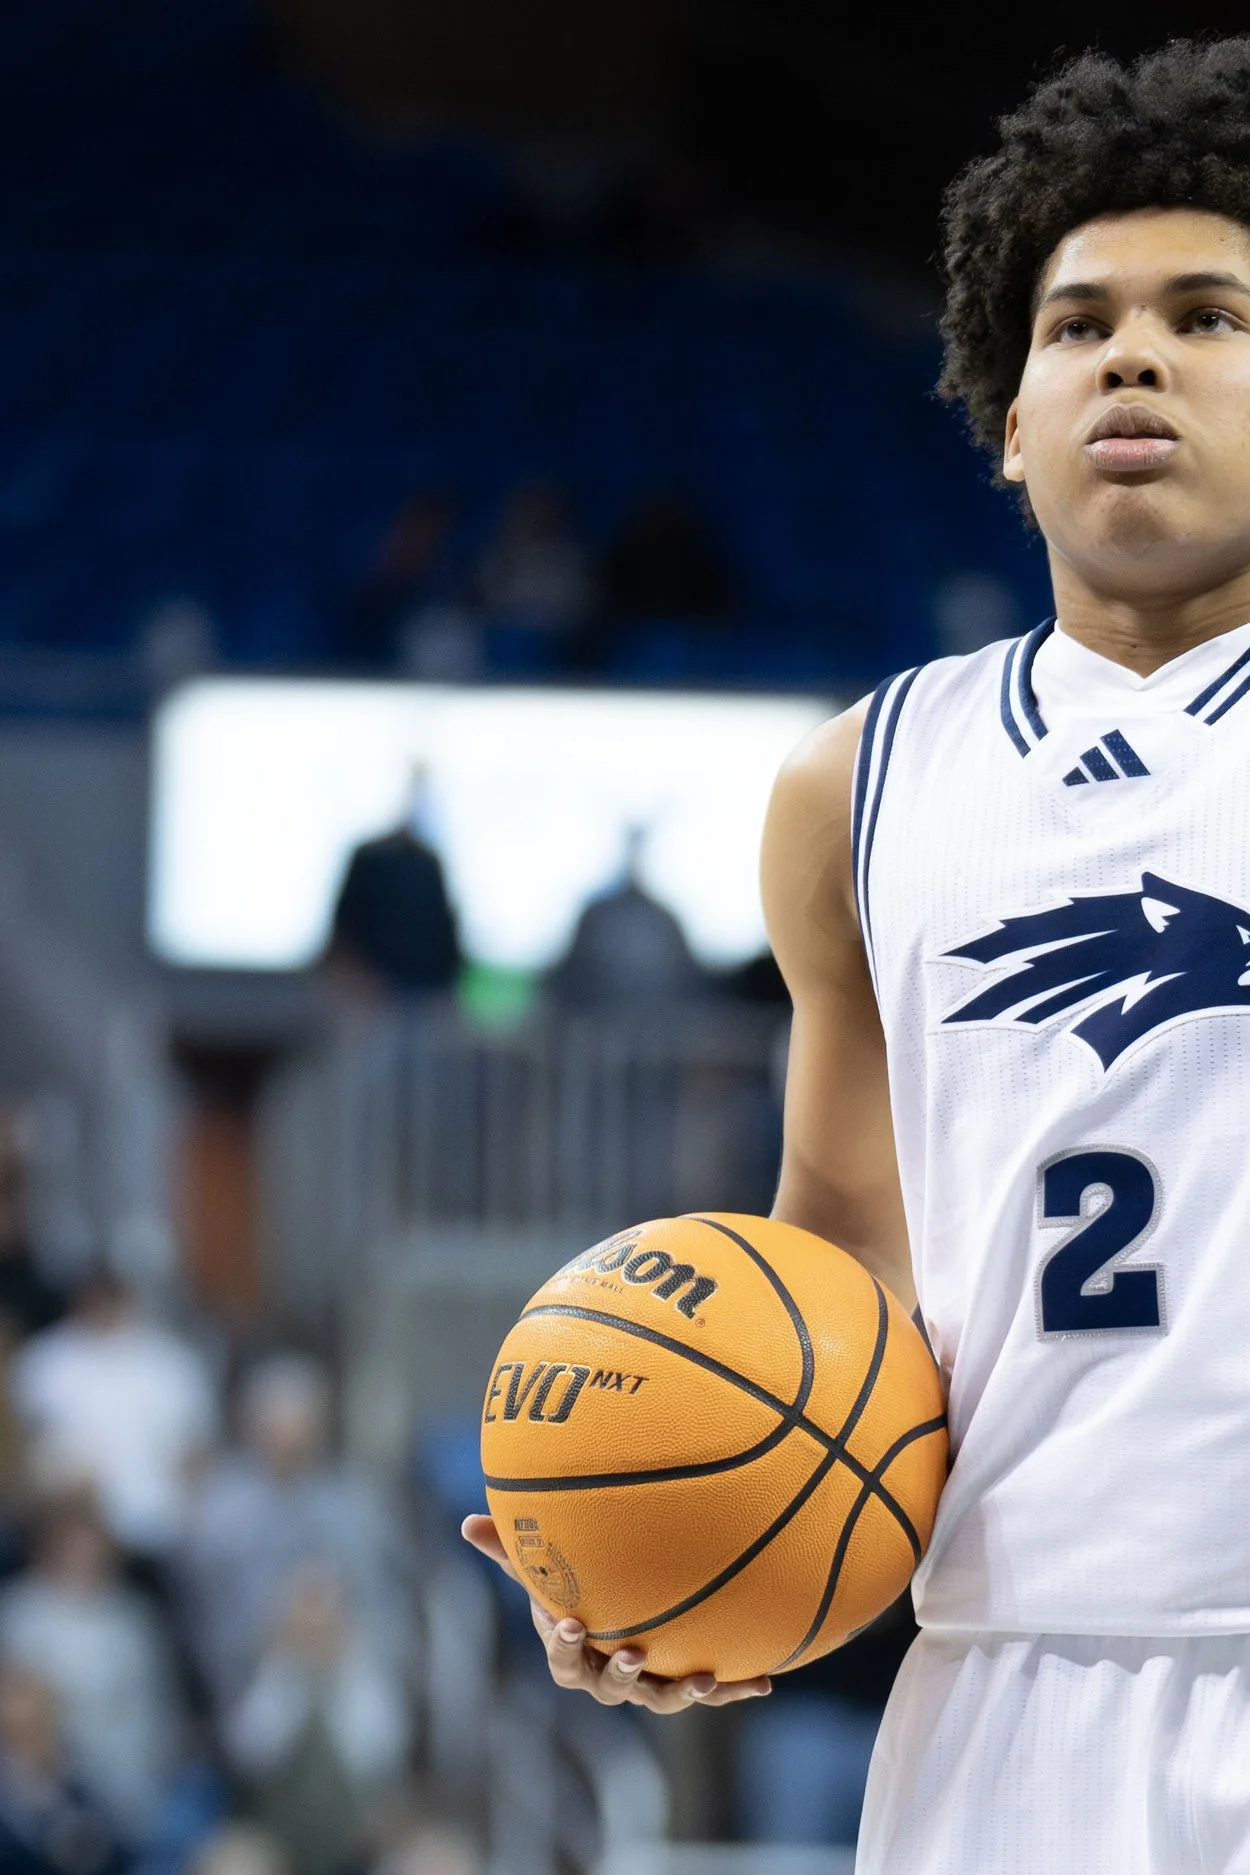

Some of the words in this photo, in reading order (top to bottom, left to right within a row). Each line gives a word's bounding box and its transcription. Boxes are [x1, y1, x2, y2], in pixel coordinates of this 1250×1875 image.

[1035, 1144, 1167, 1341] 2
[484, 1361, 592, 1425] EVO
[589, 1368, 650, 1396] NXT
